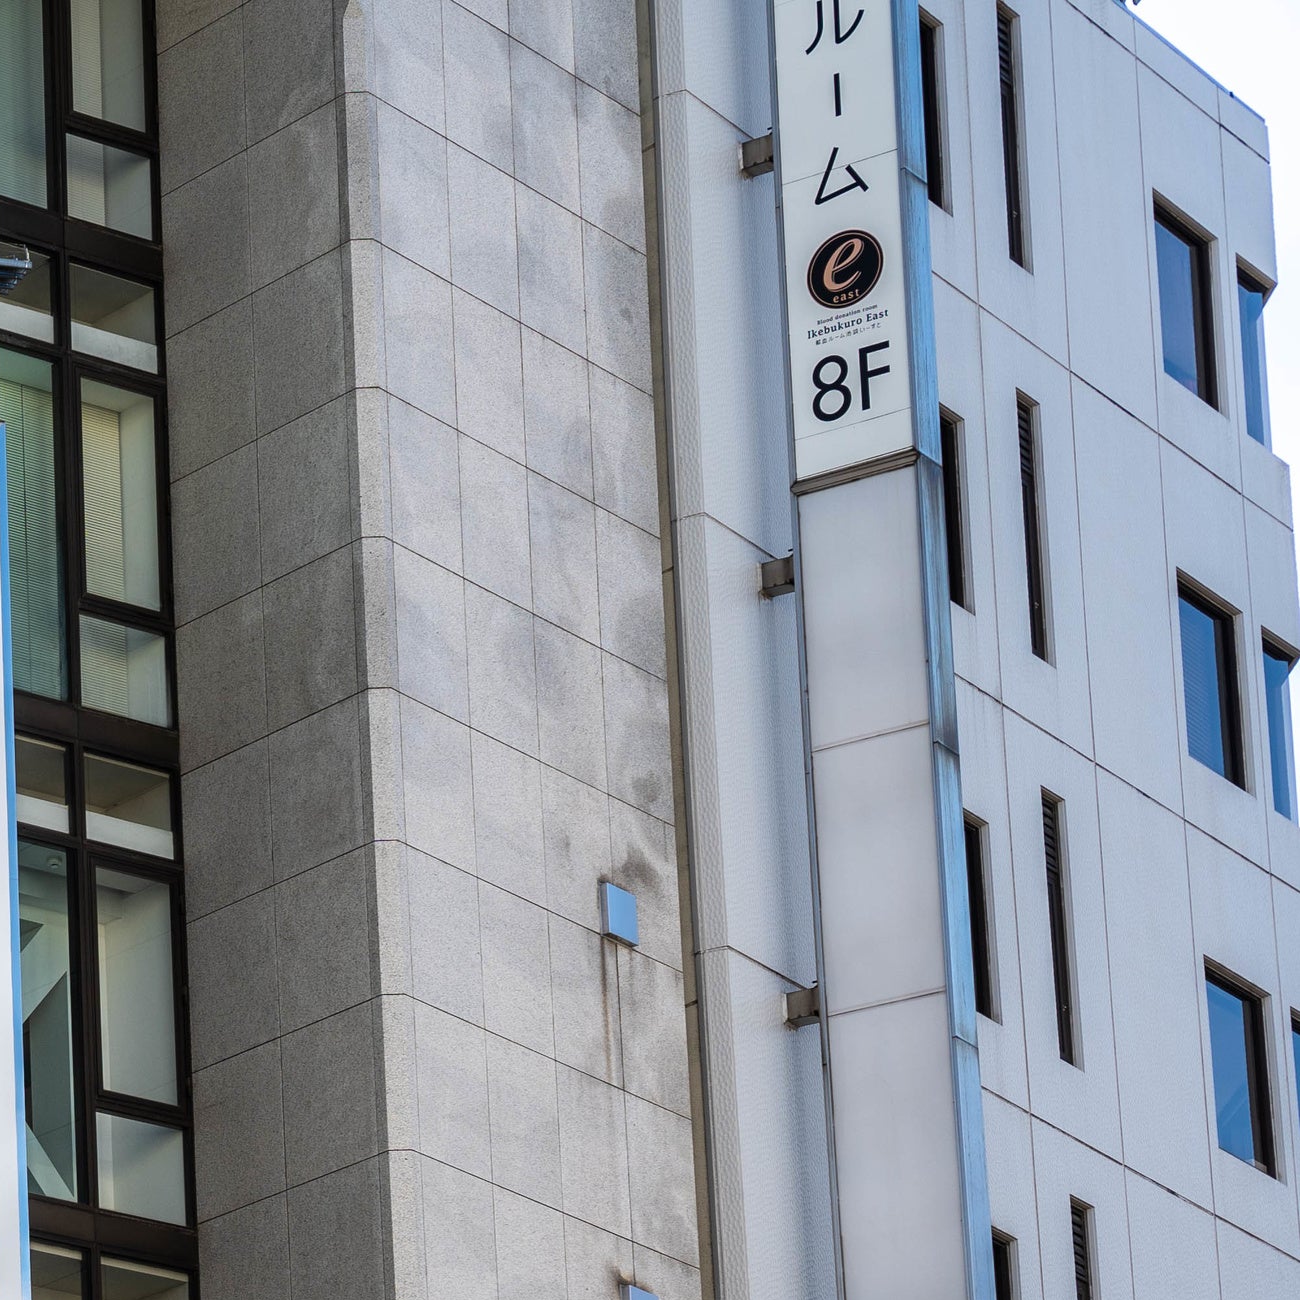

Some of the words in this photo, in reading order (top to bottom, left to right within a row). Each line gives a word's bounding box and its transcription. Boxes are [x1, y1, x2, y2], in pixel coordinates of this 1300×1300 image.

[805, 0, 869, 205] ルーム
[832, 288, 860, 303] east
[807, 317, 863, 339] Ikebukuro
[866, 309, 889, 323] East
[817, 315, 833, 325] Blood
[835, 309, 860, 320] donation
[862, 304, 878, 312] room
[811, 340, 890, 422] 8F
